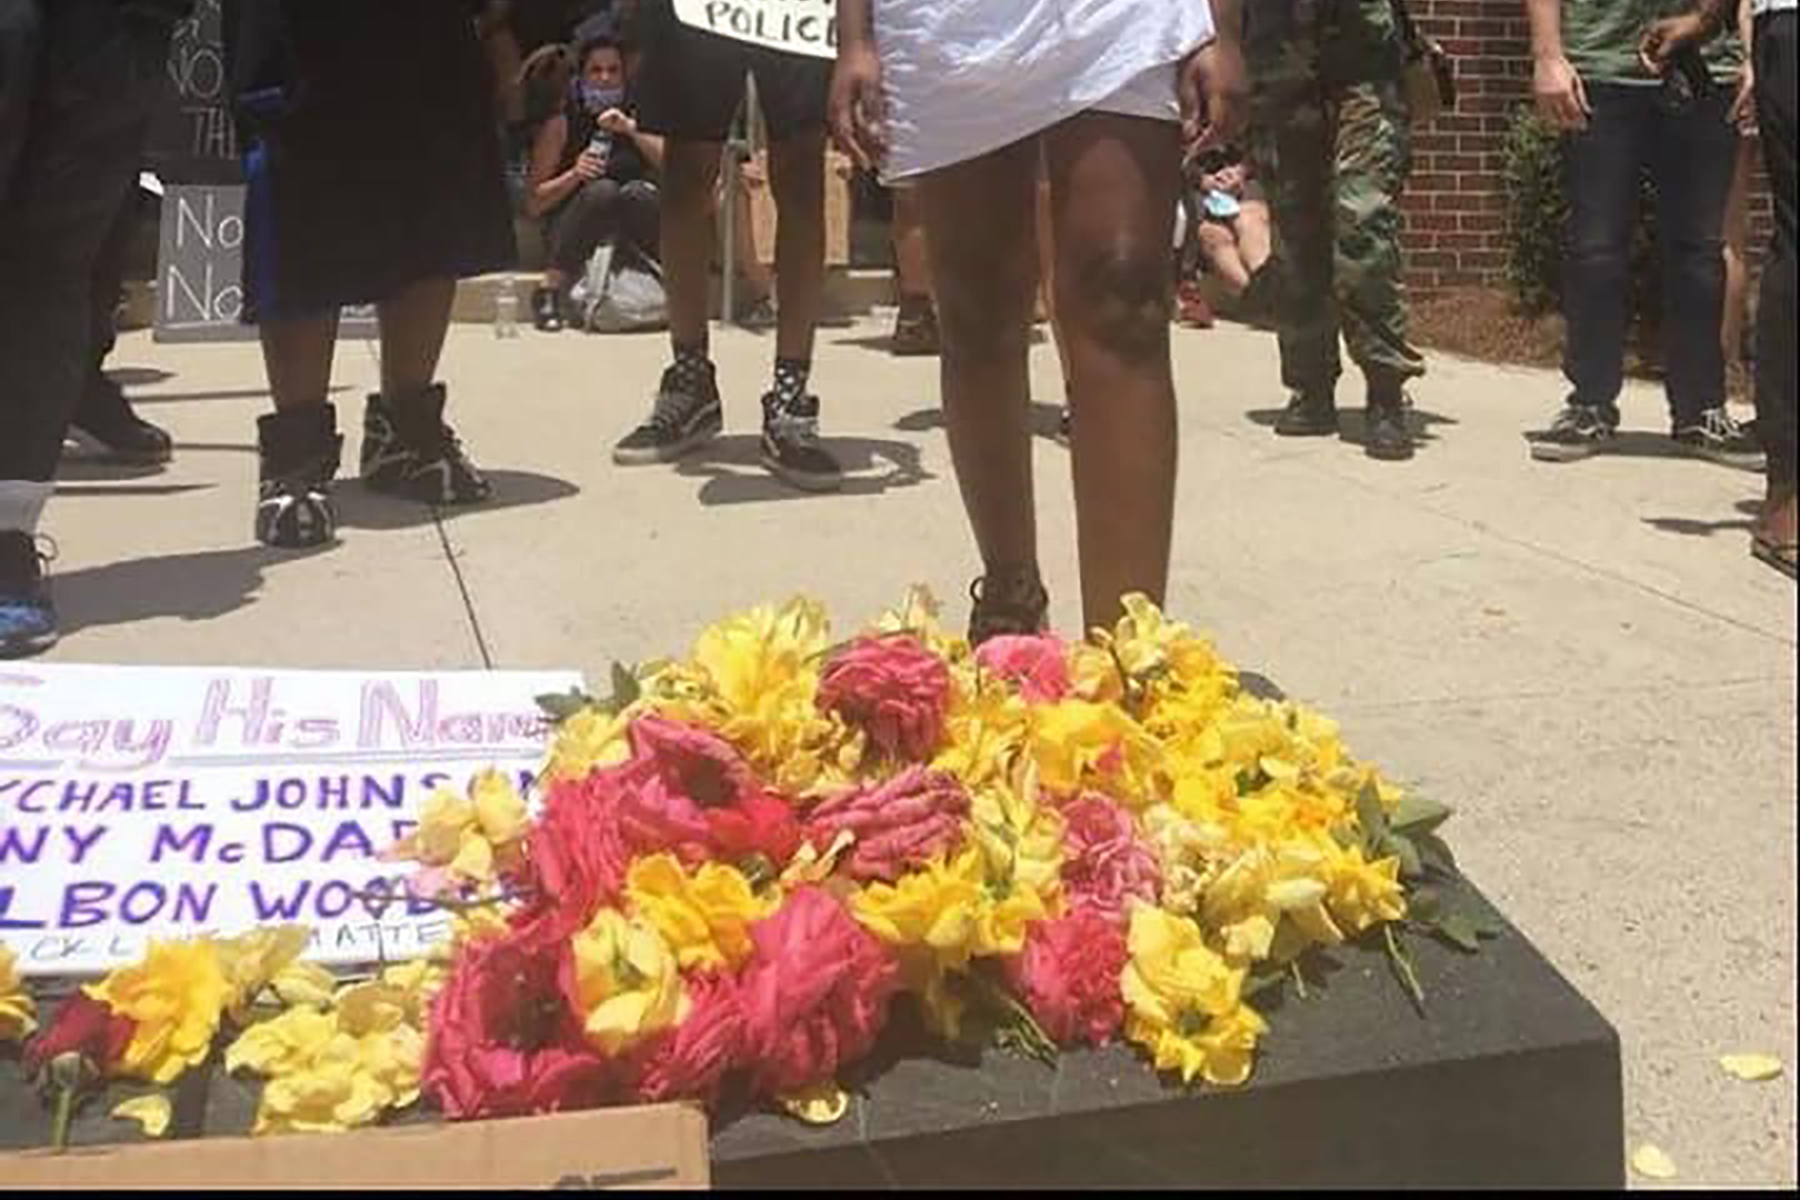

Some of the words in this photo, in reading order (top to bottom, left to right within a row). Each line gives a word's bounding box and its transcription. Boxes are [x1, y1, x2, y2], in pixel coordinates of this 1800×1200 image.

[177, 194, 243, 249] No
[196, 676, 341, 748] His
[149, 819, 418, 864] McDA
